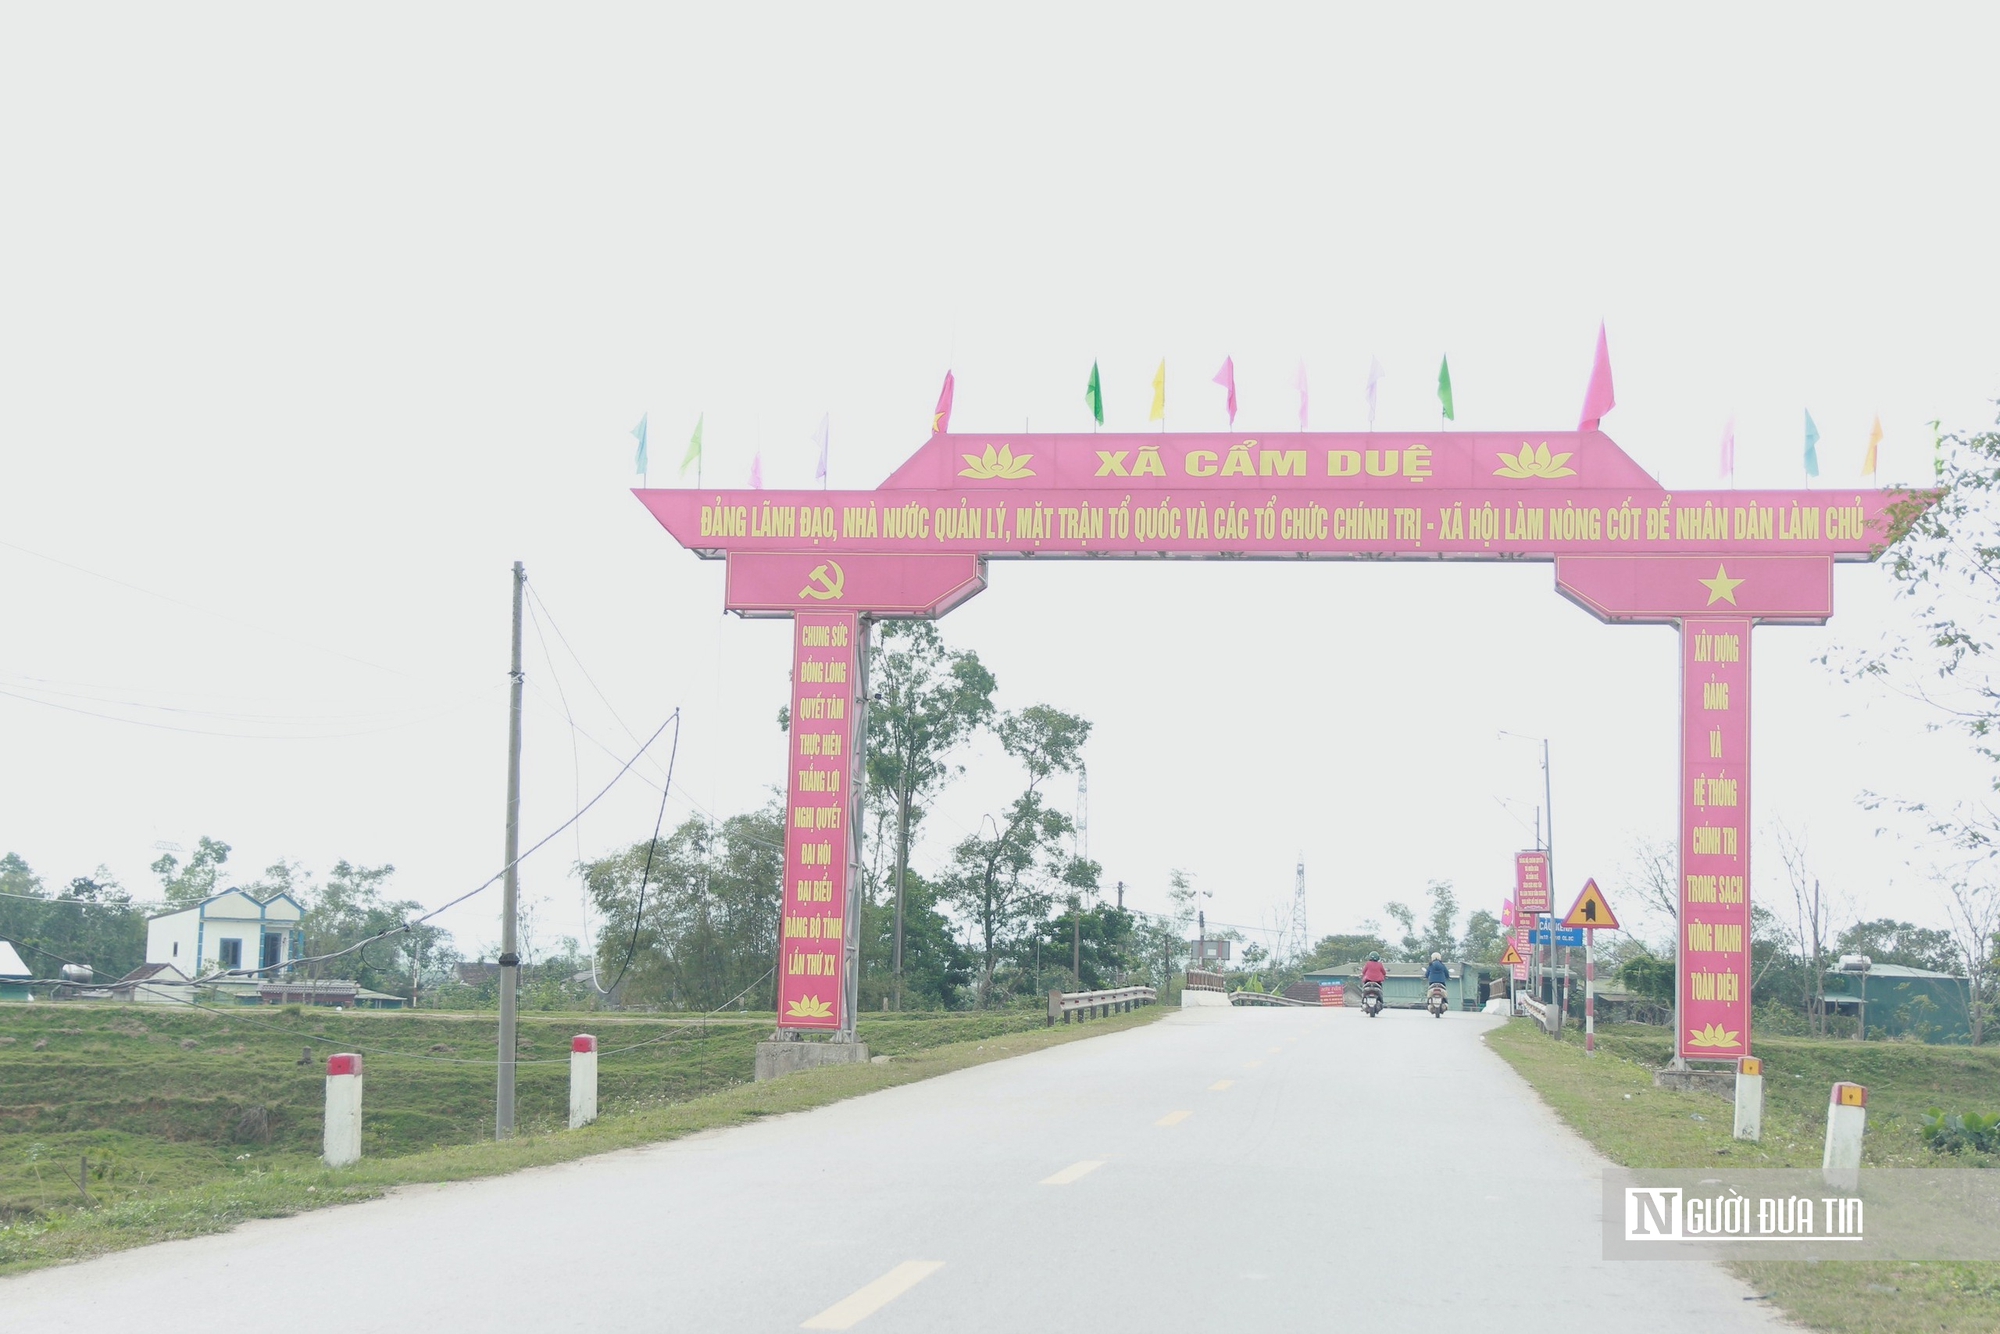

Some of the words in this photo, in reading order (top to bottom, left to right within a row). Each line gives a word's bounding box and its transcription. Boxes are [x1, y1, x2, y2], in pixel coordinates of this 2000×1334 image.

[1095, 446, 1166, 476] XÃ
[1185, 440, 1306, 476] CẨM
[1328, 445, 1432, 482] DUỆ
[701, 496, 746, 536] ĐẢNG
[752, 500, 795, 537] LÃNH
[800, 507, 837, 544] ĐẠO,
[843, 501, 877, 537] NHÀ
[883, 501, 929, 538] NƯỚC
[935, 498, 981, 542] QUẢN
[987, 501, 1010, 542] LÝ,
[1016, 501, 1053, 545] MẶT
[1058, 501, 1103, 545] TRẬN
[1109, 495, 1130, 539] TỔ
[1135, 497, 1181, 542] QUỐC
[1187, 501, 1208, 538] VÀ
[1214, 501, 1249, 539] CÁC
[1254, 495, 1276, 539] TỔ
[1281, 501, 1328, 539] CHỨC
[1334, 501, 1388, 540] CHÍNH
[1394, 508, 1421, 546] TRỊ
[1439, 502, 1463, 539] XÃ
[1469, 501, 1499, 547] HỘI
[1505, 501, 1543, 540] LÀM
[1550, 500, 1600, 540] NÒNG
[1607, 497, 1641, 540] CỐT
[1646, 495, 1671, 539] ĐỂ
[1676, 501, 1728, 539] NHÂN
[1735, 501, 1770, 539] DÂN
[1780, 500, 1819, 539] LÀM
[1826, 496, 1863, 539] CHỦ
[803, 626, 829, 646] CHUNG
[832, 622, 847, 646] SỨC
[1695, 629, 1712, 661] XÂY
[1715, 632, 1738, 668] DỰNG
[801, 655, 823, 682] ĐỒNG
[825, 657, 846, 683] LÒNG
[800, 692, 825, 721] QUYẾT
[827, 694, 844, 719] TÂM
[1704, 674, 1728, 710] ĐẢNG
[800, 733, 820, 759] THỰC
[822, 730, 841, 760] HIỆN
[1710, 725, 1721, 757] VÀ
[827, 769, 839, 796] LỢI
[1694, 773, 1705, 812] HỆ
[1708, 769, 1737, 806] THỐNG
[795, 807, 814, 832] NGHỊ
[816, 801, 841, 830] QUYẾT
[802, 844, 815, 869] ĐẠI
[817, 840, 831, 869] HỘI
[1693, 821, 1720, 854] CHÍNH
[1723, 828, 1737, 861] TRỊ
[798, 880, 811, 906] ĐẠI
[813, 872, 832, 902] BIỂU
[1687, 875, 1716, 903] TRONG
[1719, 876, 1742, 909] SẠCH
[785, 909, 808, 938] ĐẢNG
[809, 912, 822, 944] BỘ
[822, 909, 842, 939] TỈNH
[1688, 919, 1712, 951] VỮNG
[1715, 924, 1741, 958] MẠNH
[789, 946, 805, 975] LẦN
[807, 950, 823, 975] THỨ
[824, 955, 835, 975] XX
[1691, 967, 1715, 1000] TOÀN
[1717, 968, 1738, 1007] DIỆN
